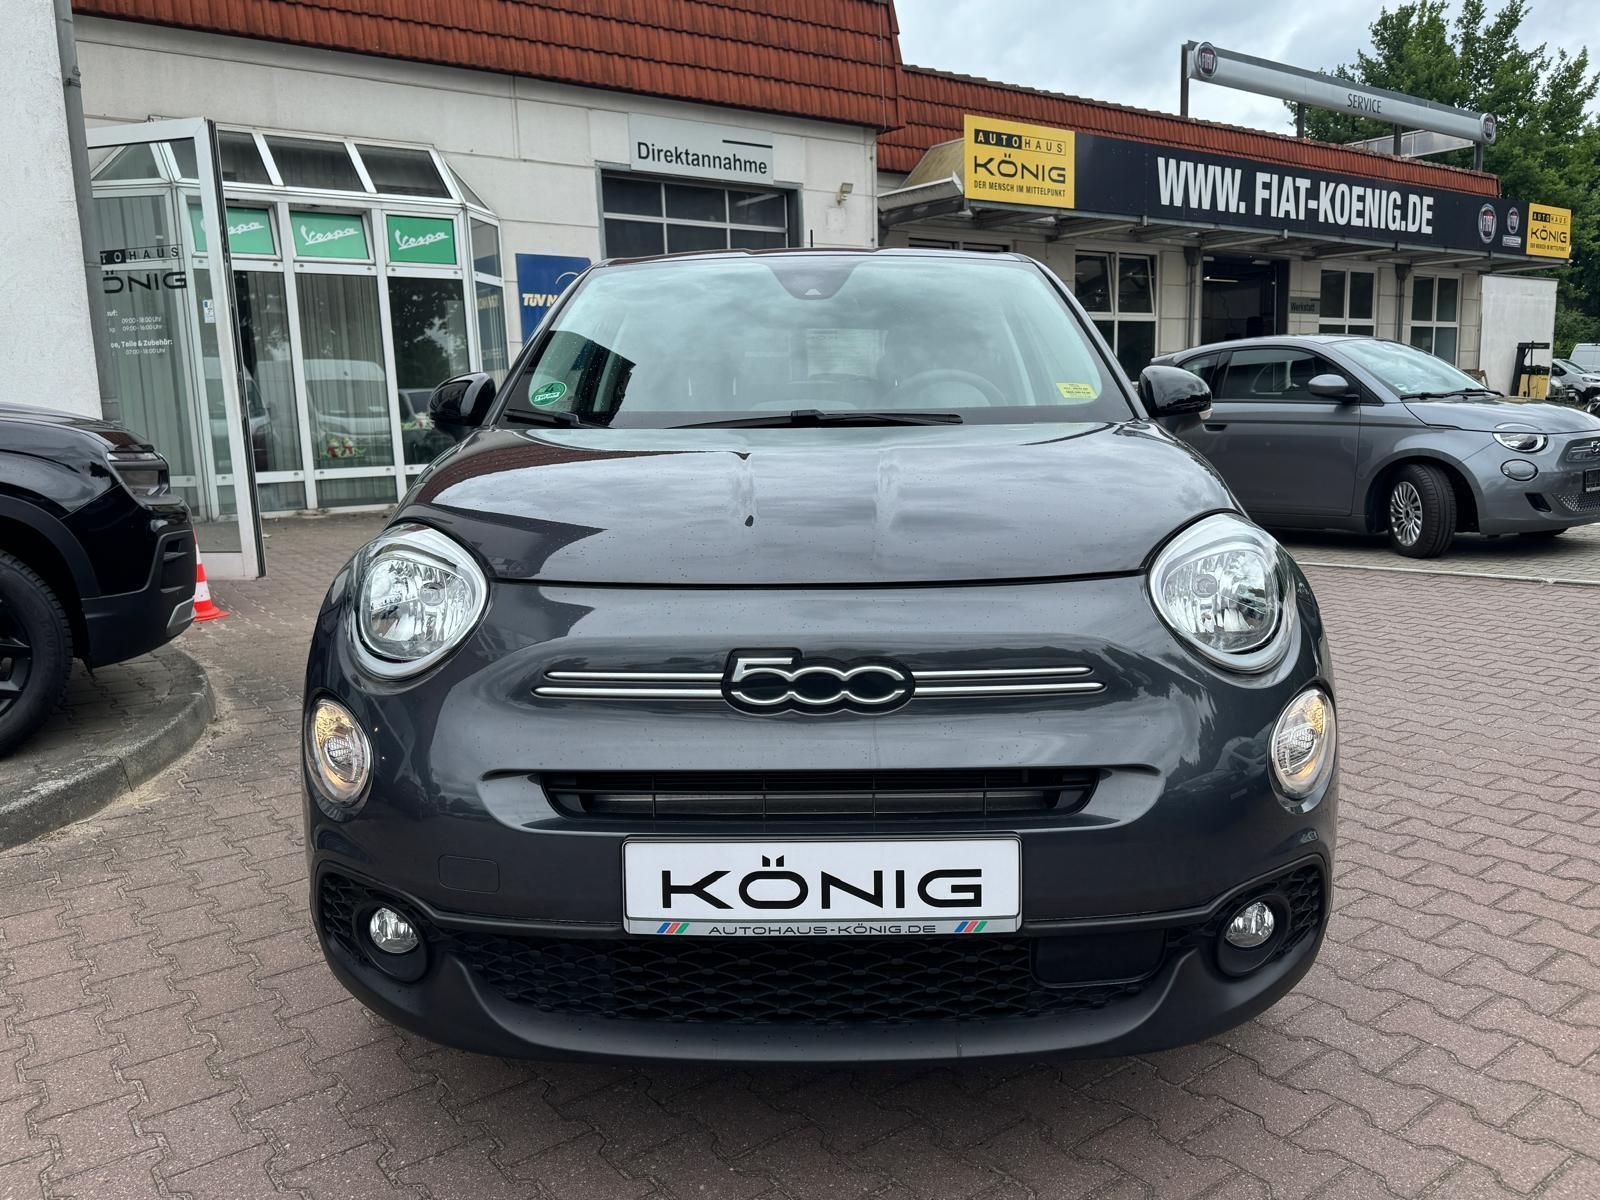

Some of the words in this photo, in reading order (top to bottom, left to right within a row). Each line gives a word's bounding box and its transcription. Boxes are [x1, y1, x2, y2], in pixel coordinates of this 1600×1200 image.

[1347, 93, 1381, 114] SERVICE
[977, 131, 1063, 153] AUTOHAUS
[637, 141, 768, 174] Direktannahme
[974, 152, 1066, 184] KÖNIG
[974, 179, 987, 189] DER
[988, 182, 1015, 192] MENSCH
[1016, 184, 1024, 193] IM
[1025, 186, 1066, 197] MITTELPUNKT
[1157, 156, 1246, 214] WWW.
[1255, 171, 1434, 235] FIAT-KOENIG.DE
[1483, 215, 1493, 232] FIAT
[1531, 225, 1567, 243] KÖNIG
[301, 225, 360, 246] Vespa
[395, 229, 449, 250] Vespa
[100, 247, 179, 263] TOHAUS
[103, 270, 187, 293] ÖNIG
[522, 293, 546, 306] TÜV
[547, 293, 559, 306] N
[731, 657, 905, 706] 500
[662, 855, 982, 910] KÖNIG
[708, 923, 937, 936] AUTOHAUS-KÖNIG.DE
